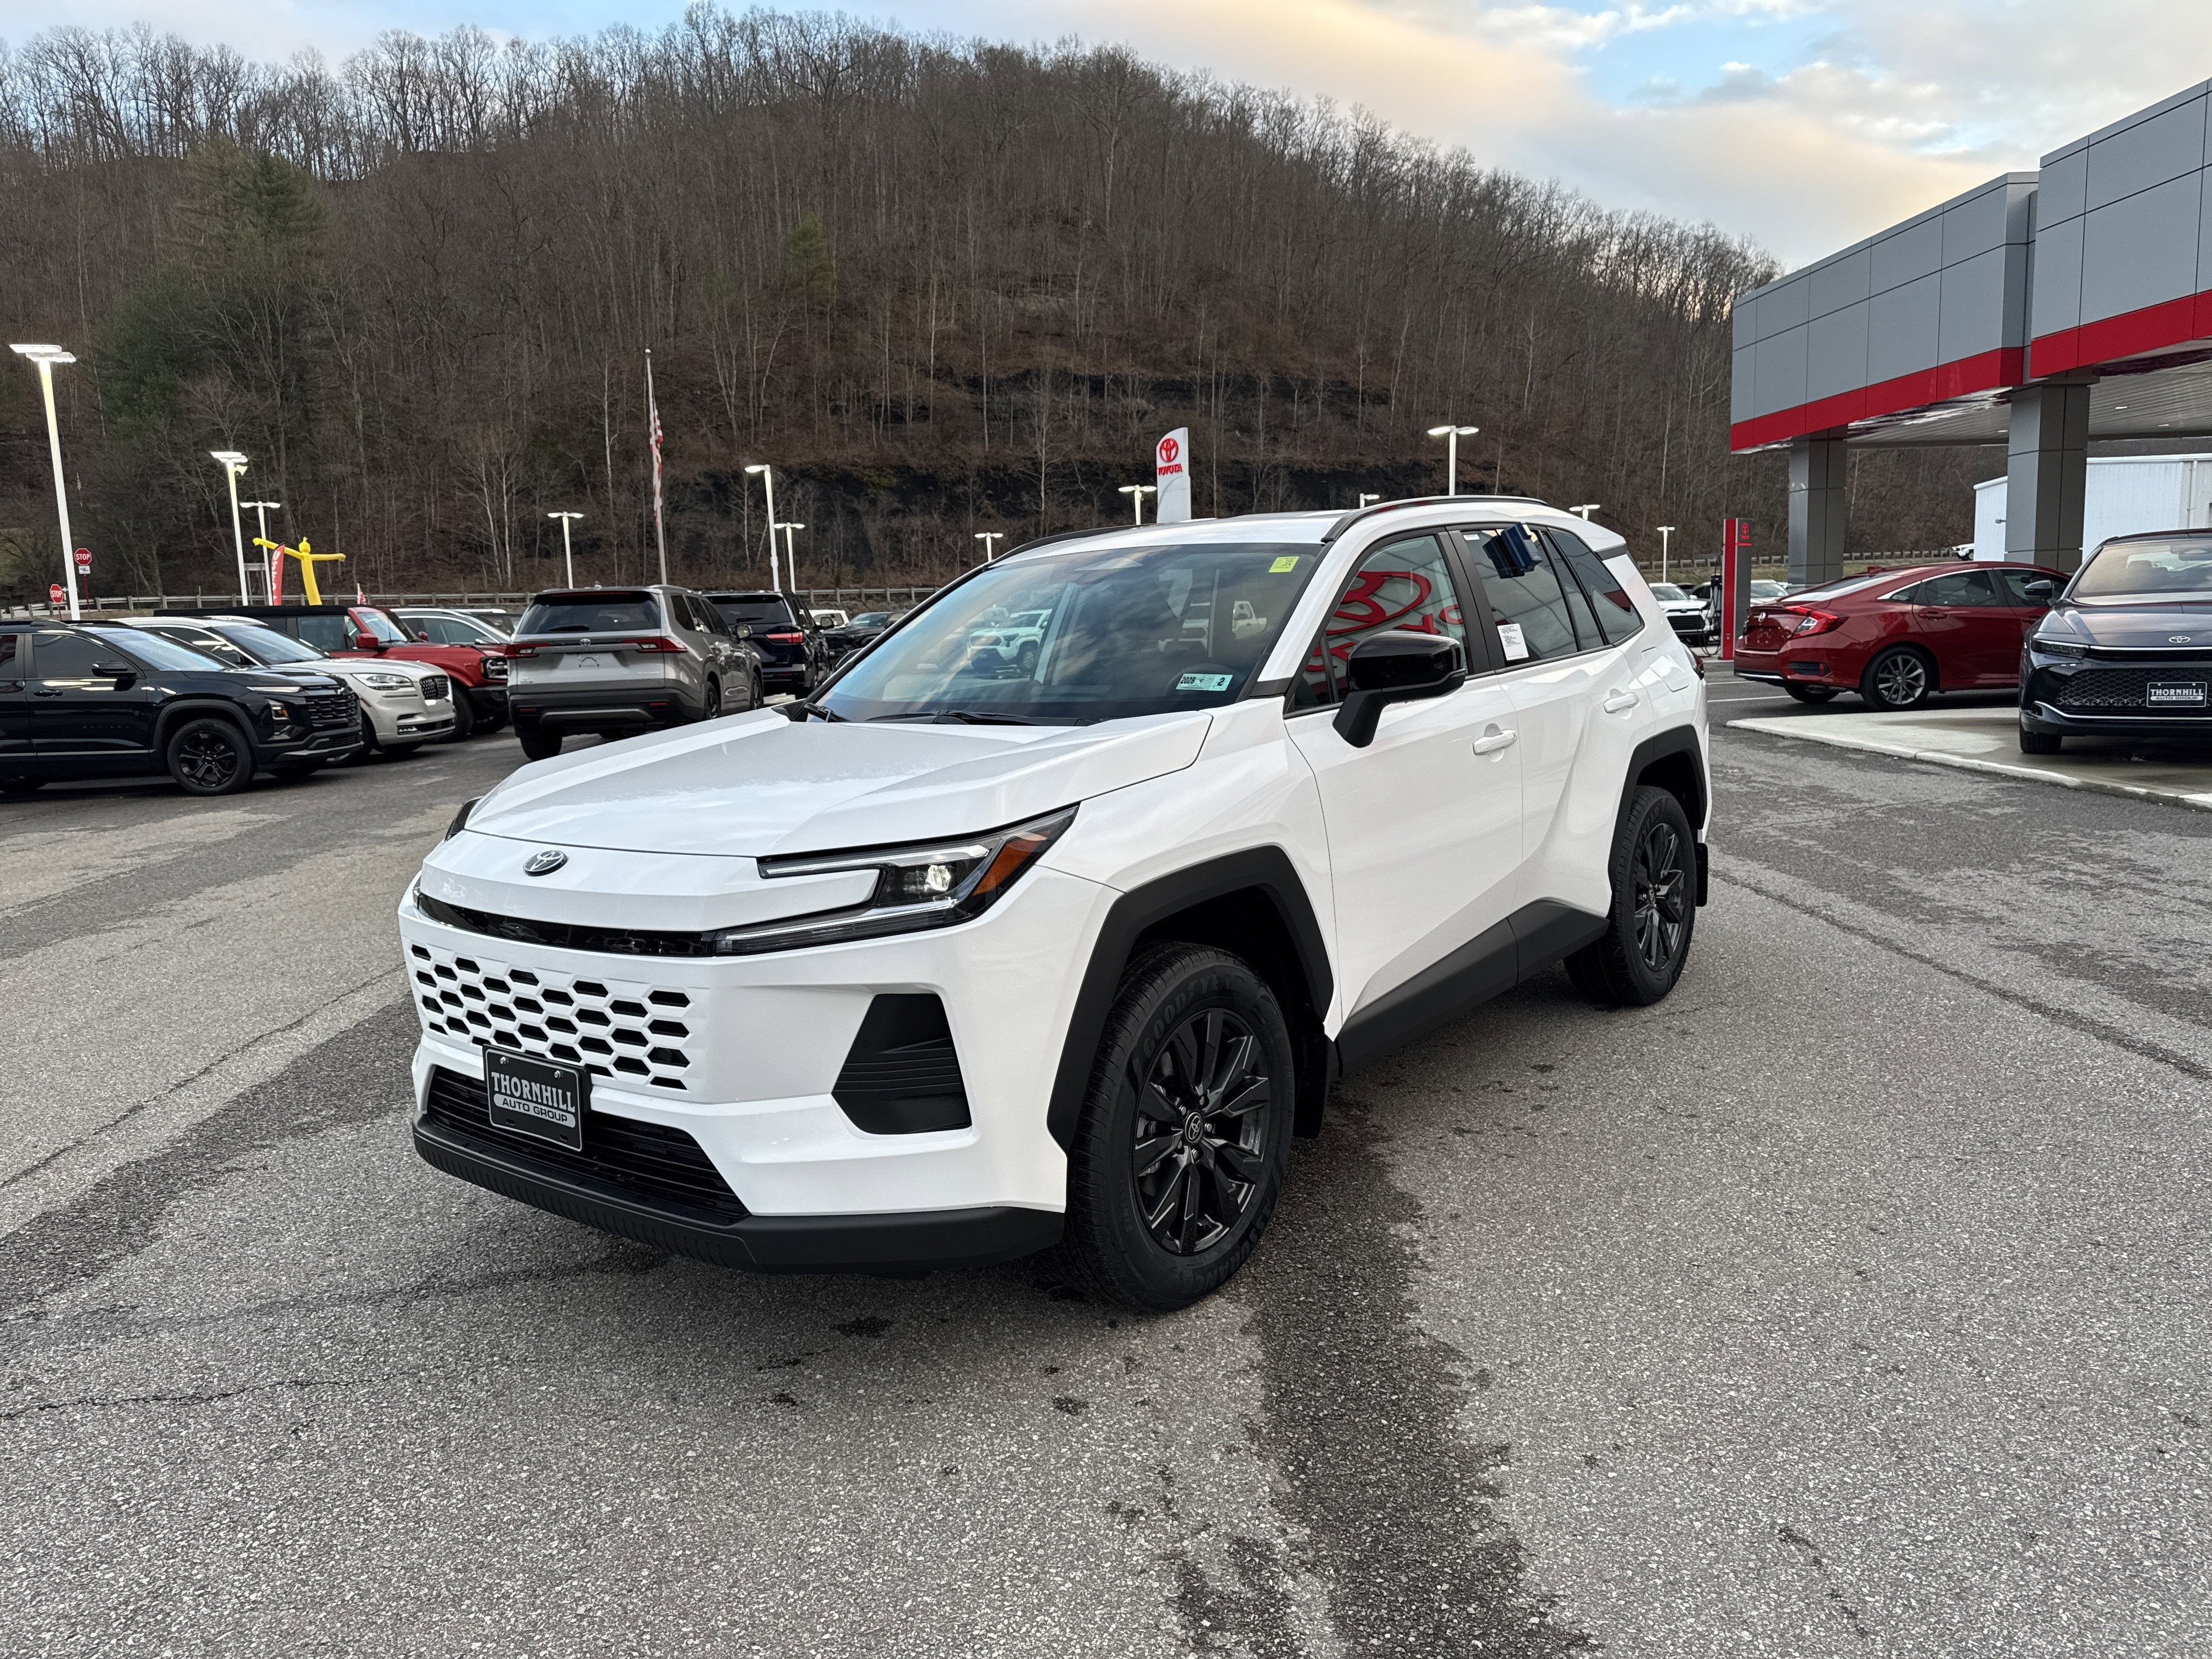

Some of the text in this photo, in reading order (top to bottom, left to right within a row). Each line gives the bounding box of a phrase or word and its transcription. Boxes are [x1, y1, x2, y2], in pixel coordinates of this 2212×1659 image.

[1158, 463, 1182, 476] TOYOTA
[50, 590, 62, 598] STOP
[1180, 676, 1225, 686] 2028 2
[491, 1071, 575, 1113] THORNHILL
[503, 1098, 567, 1122] AUTO GROUP
